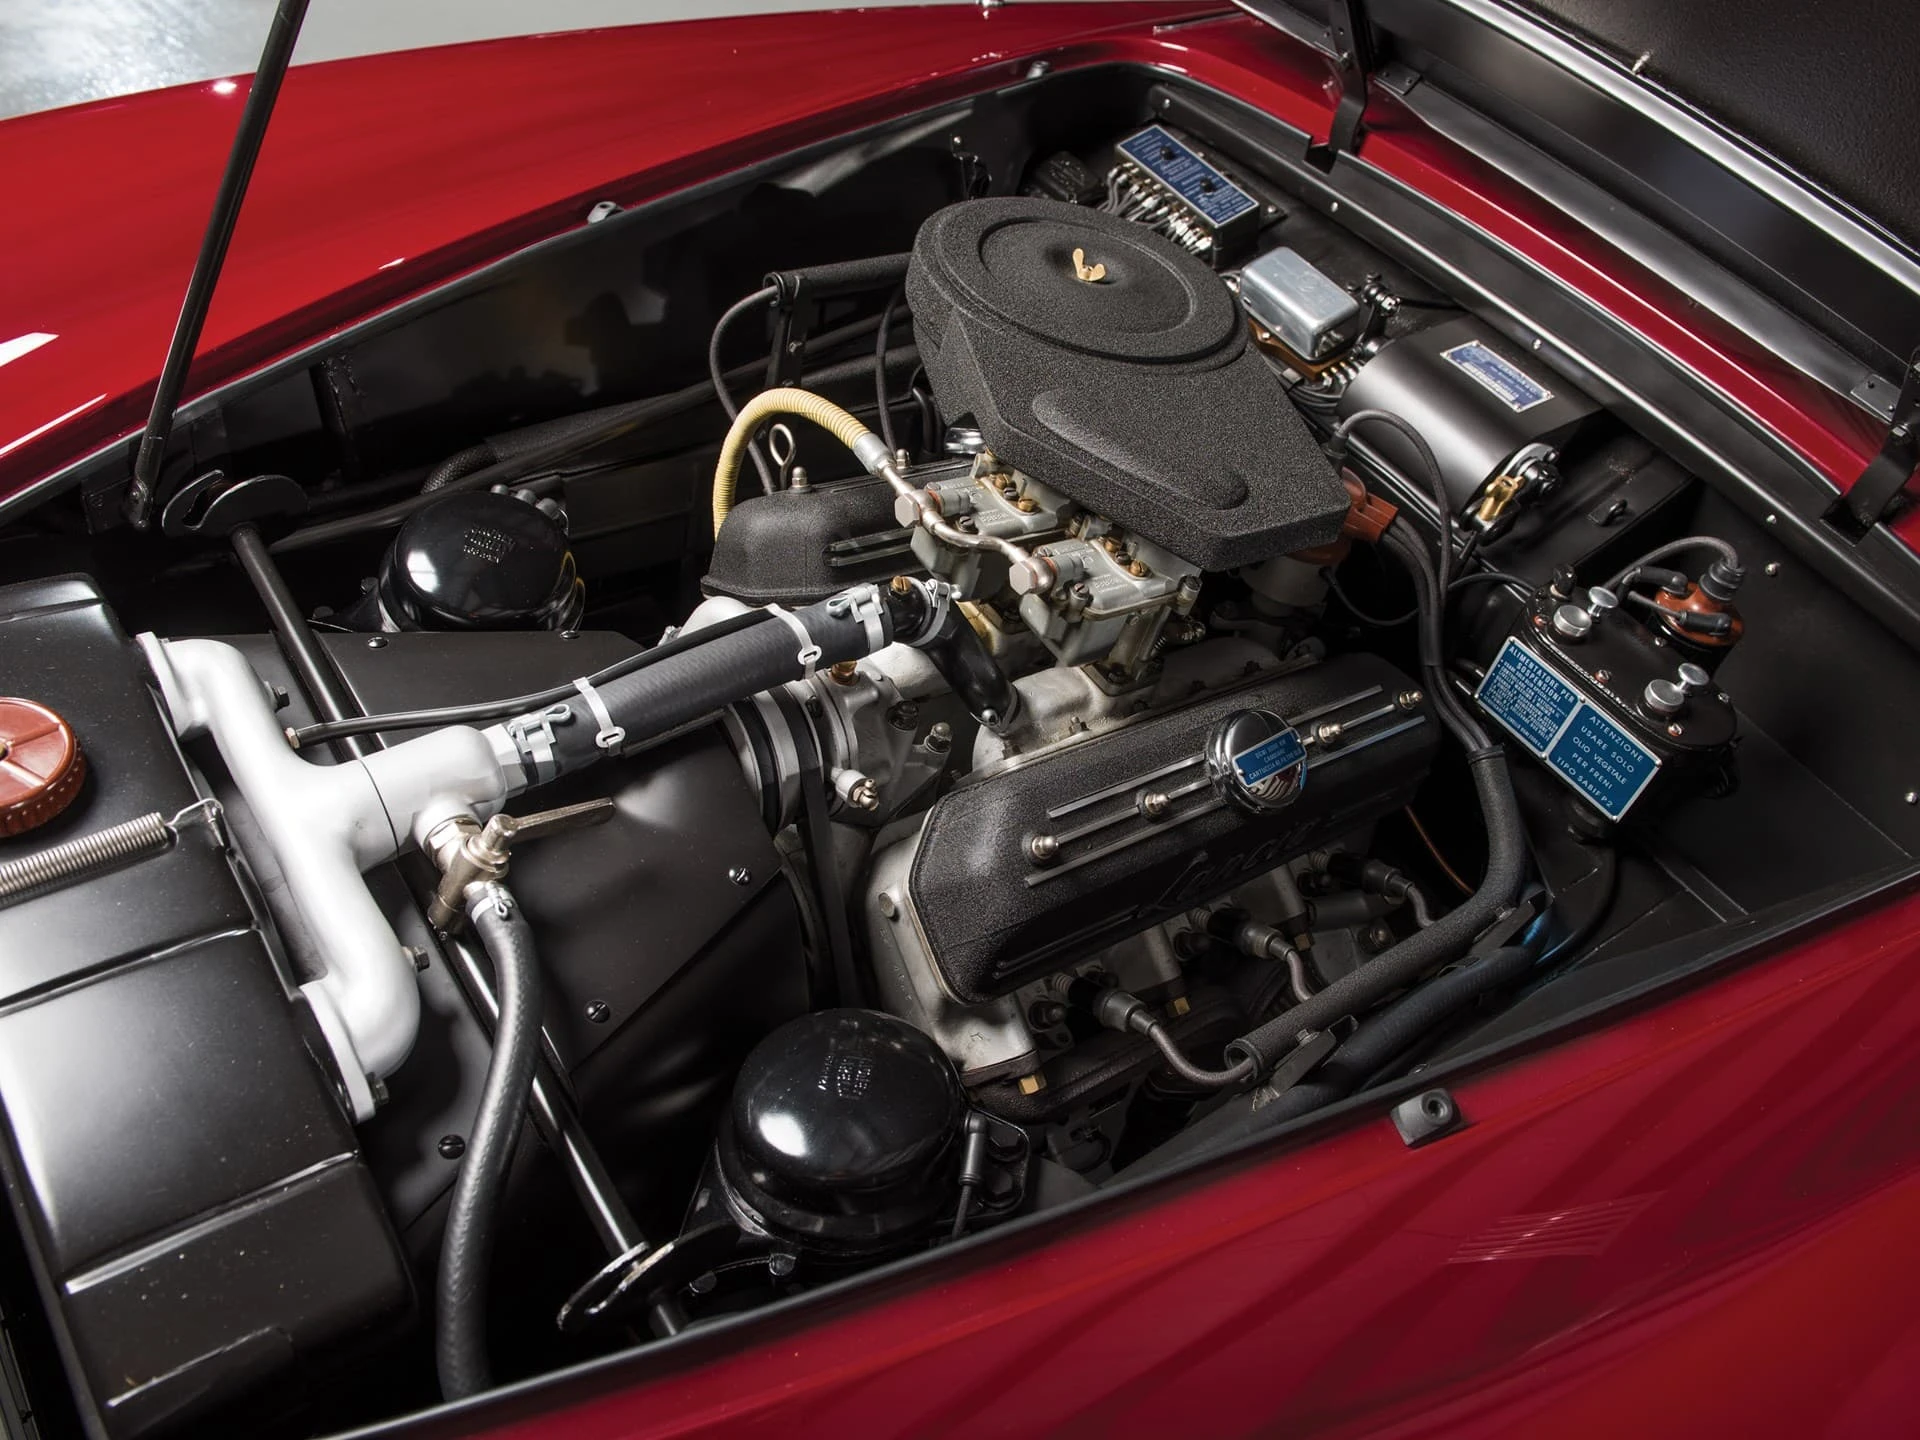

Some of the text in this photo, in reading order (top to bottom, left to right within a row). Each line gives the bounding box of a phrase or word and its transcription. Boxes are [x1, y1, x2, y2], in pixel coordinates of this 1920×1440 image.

[1508, 644, 1575, 704] ALIMENTATORE PER
[1516, 661, 1562, 703] SOSPENSIONI
[1571, 735, 1628, 785] OLIO VEGETALE
[1579, 724, 1636, 774] USARE SOLO
[1587, 714, 1644, 763] ATTENZIONE
[1555, 755, 1577, 776] TIPO
[1576, 774, 1602, 797] SABIF
[1571, 752, 1613, 790] PER FRENI
